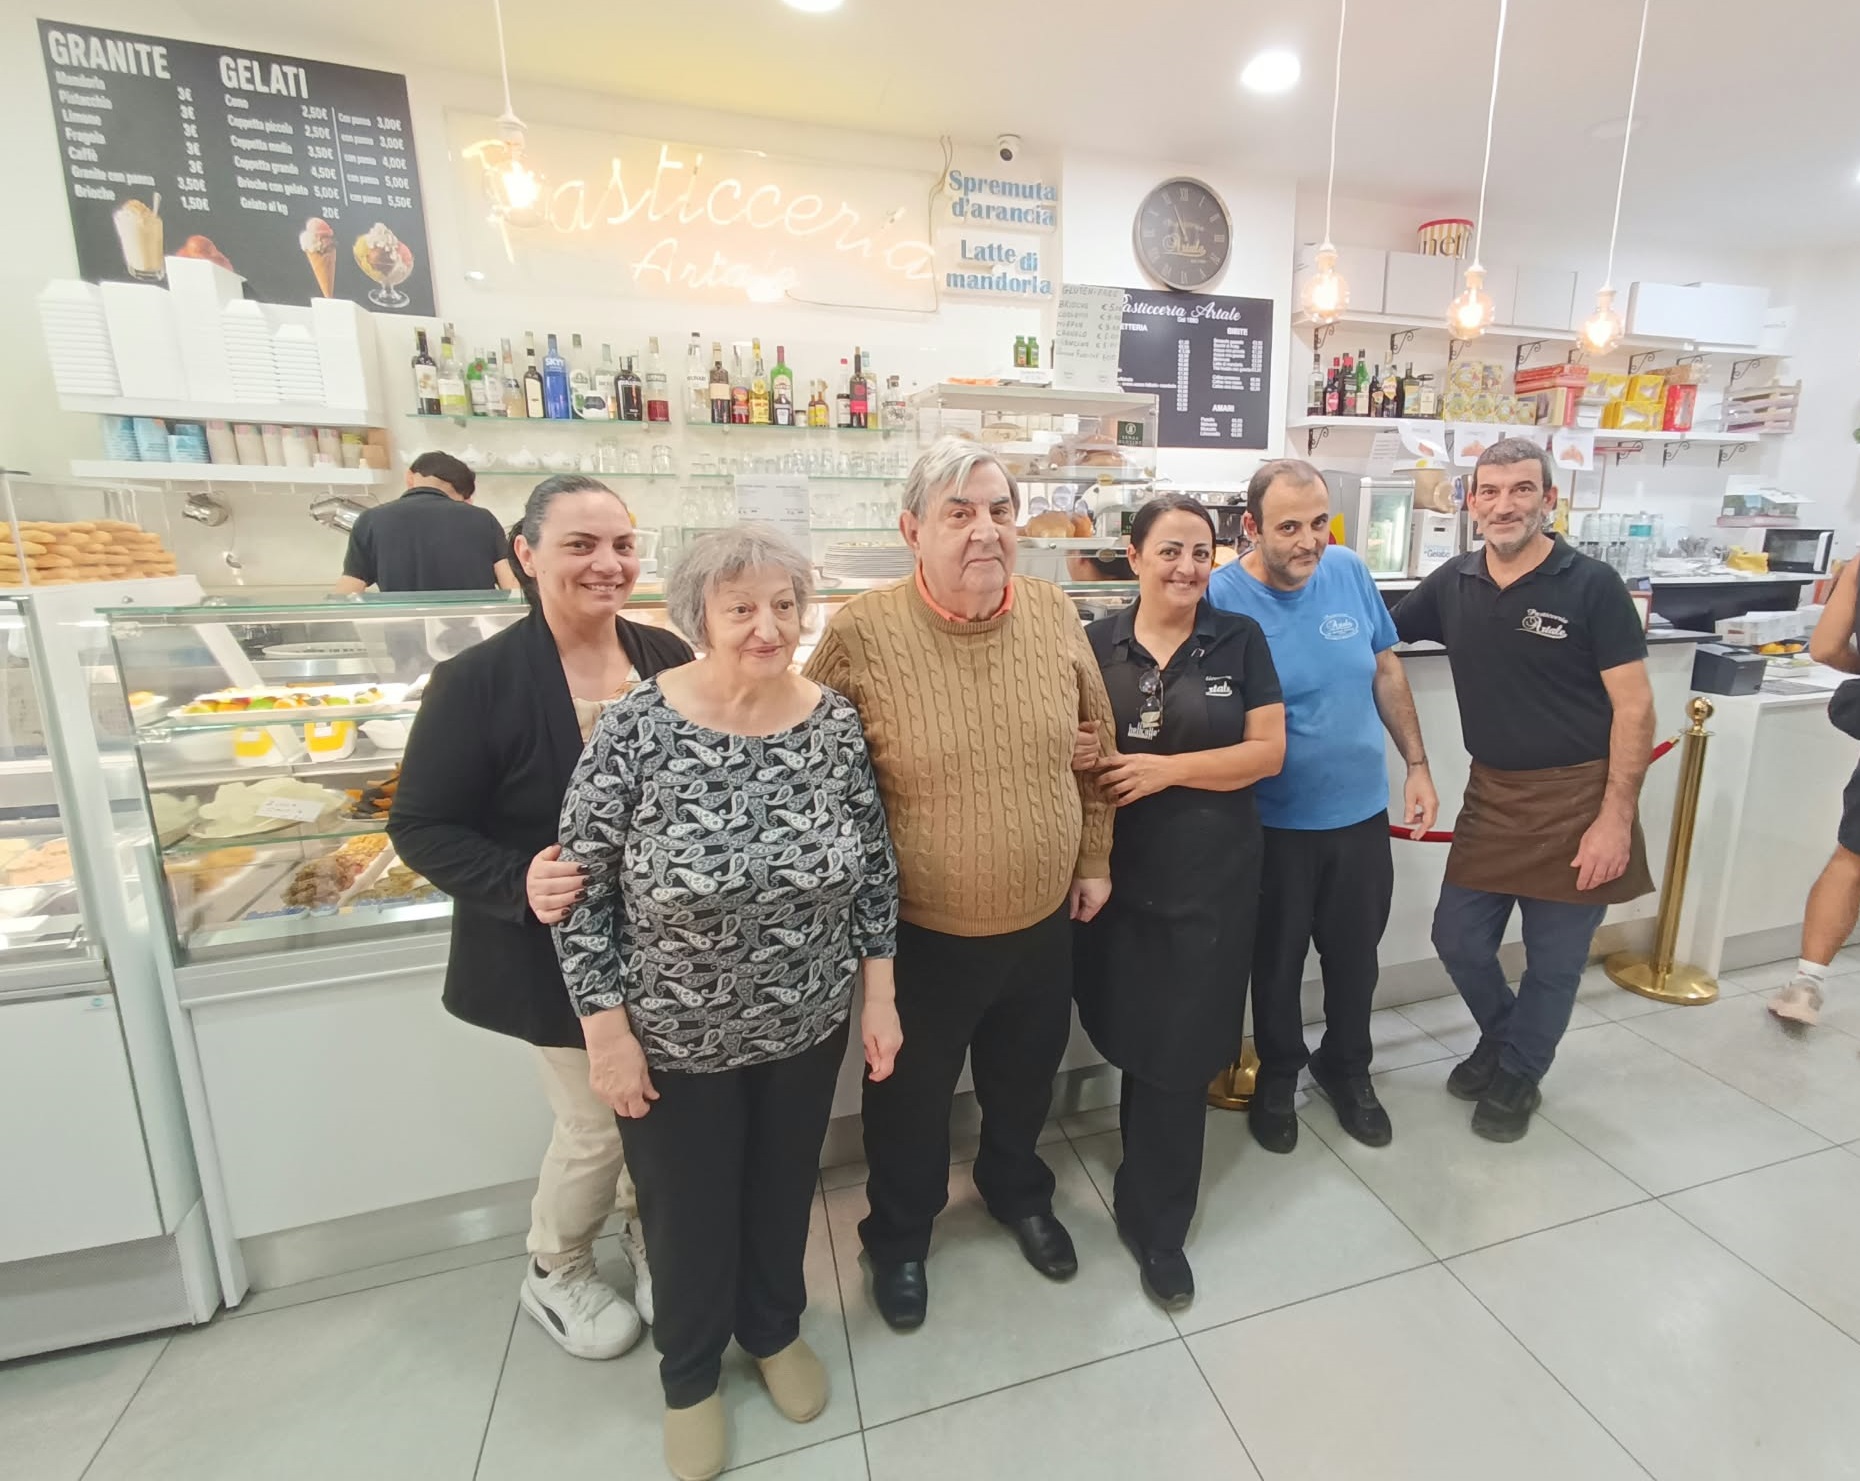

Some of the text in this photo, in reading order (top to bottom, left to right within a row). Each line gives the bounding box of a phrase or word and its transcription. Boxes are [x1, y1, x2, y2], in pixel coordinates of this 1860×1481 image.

[48, 30, 171, 80] GRANITE
[219, 54, 309, 99] GELATI
[177, 86, 193, 102] 3€
[180, 104, 196, 120] 3€
[301, 105, 328, 121] 2,50€
[183, 122, 199, 138] 3€
[376, 115, 402, 132] 3,00€
[304, 124, 331, 140] 2,50€
[186, 141, 202, 157] 3€
[379, 135, 405, 151] 3,00€
[307, 145, 334, 160] 3,50€
[189, 159, 205, 175] 3€
[382, 156, 408, 171] 4,00€
[310, 165, 337, 180] 4,50€
[177, 176, 207, 193] 3,50€
[384, 174, 410, 190] 5,00€
[949, 169, 1058, 202] Spremuta
[314, 185, 340, 200] 5,00€
[181, 195, 210, 212] 1,50€
[387, 194, 413, 210] 5,50€
[321, 206, 340, 220] 20€
[951, 197, 1056, 226] d'arancia
[960, 239, 1038, 271] Latte di
[946, 272, 1053, 295] mandorla
[1190, 301, 1242, 322] Artale
[1120, 323, 1148, 332] ETTERIA
